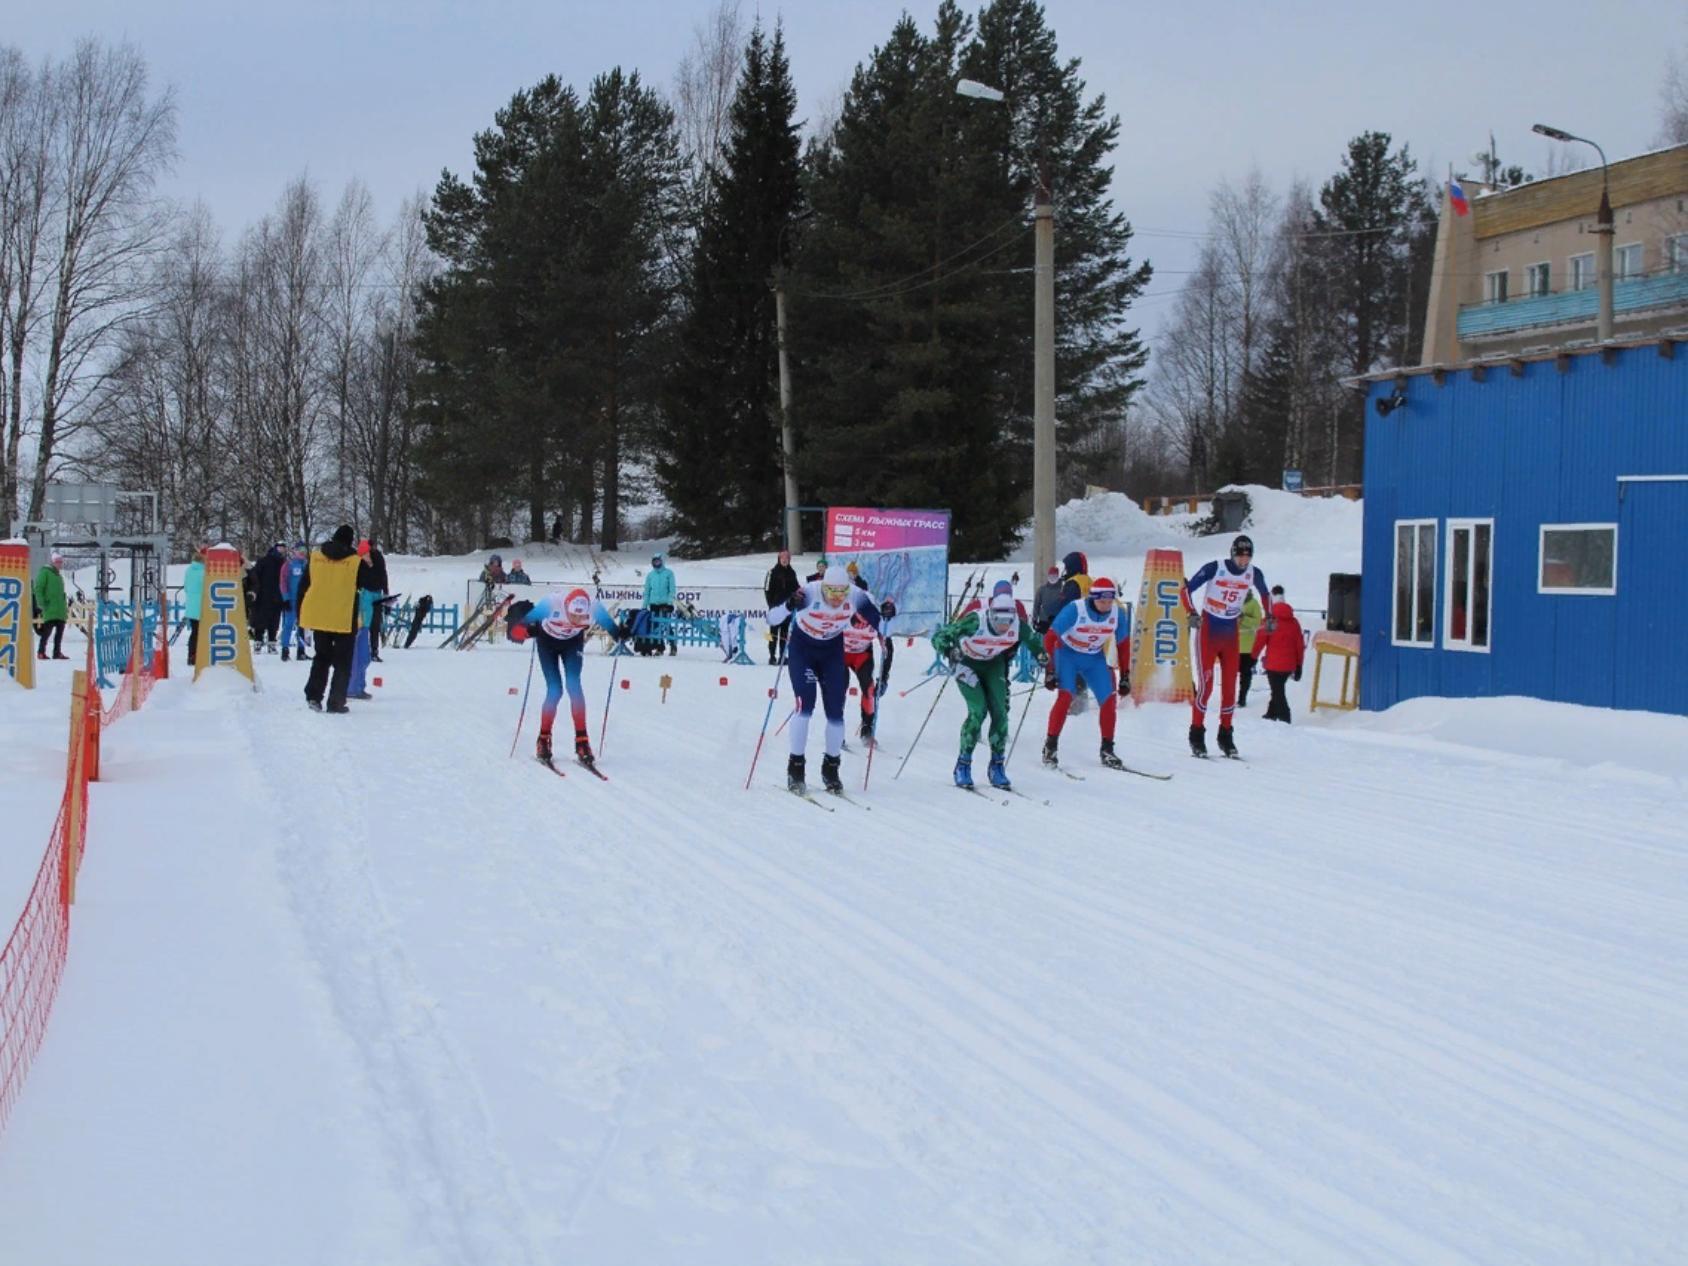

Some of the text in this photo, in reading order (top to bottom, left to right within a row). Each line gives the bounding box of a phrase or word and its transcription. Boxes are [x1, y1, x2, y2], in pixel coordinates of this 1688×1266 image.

[835, 513, 945, 529] СХЕМА ЛЫЖНЫХ ТРАСС
[595, 587, 702, 604] Лыжны орт
[1221, 590, 1240, 602] 15
